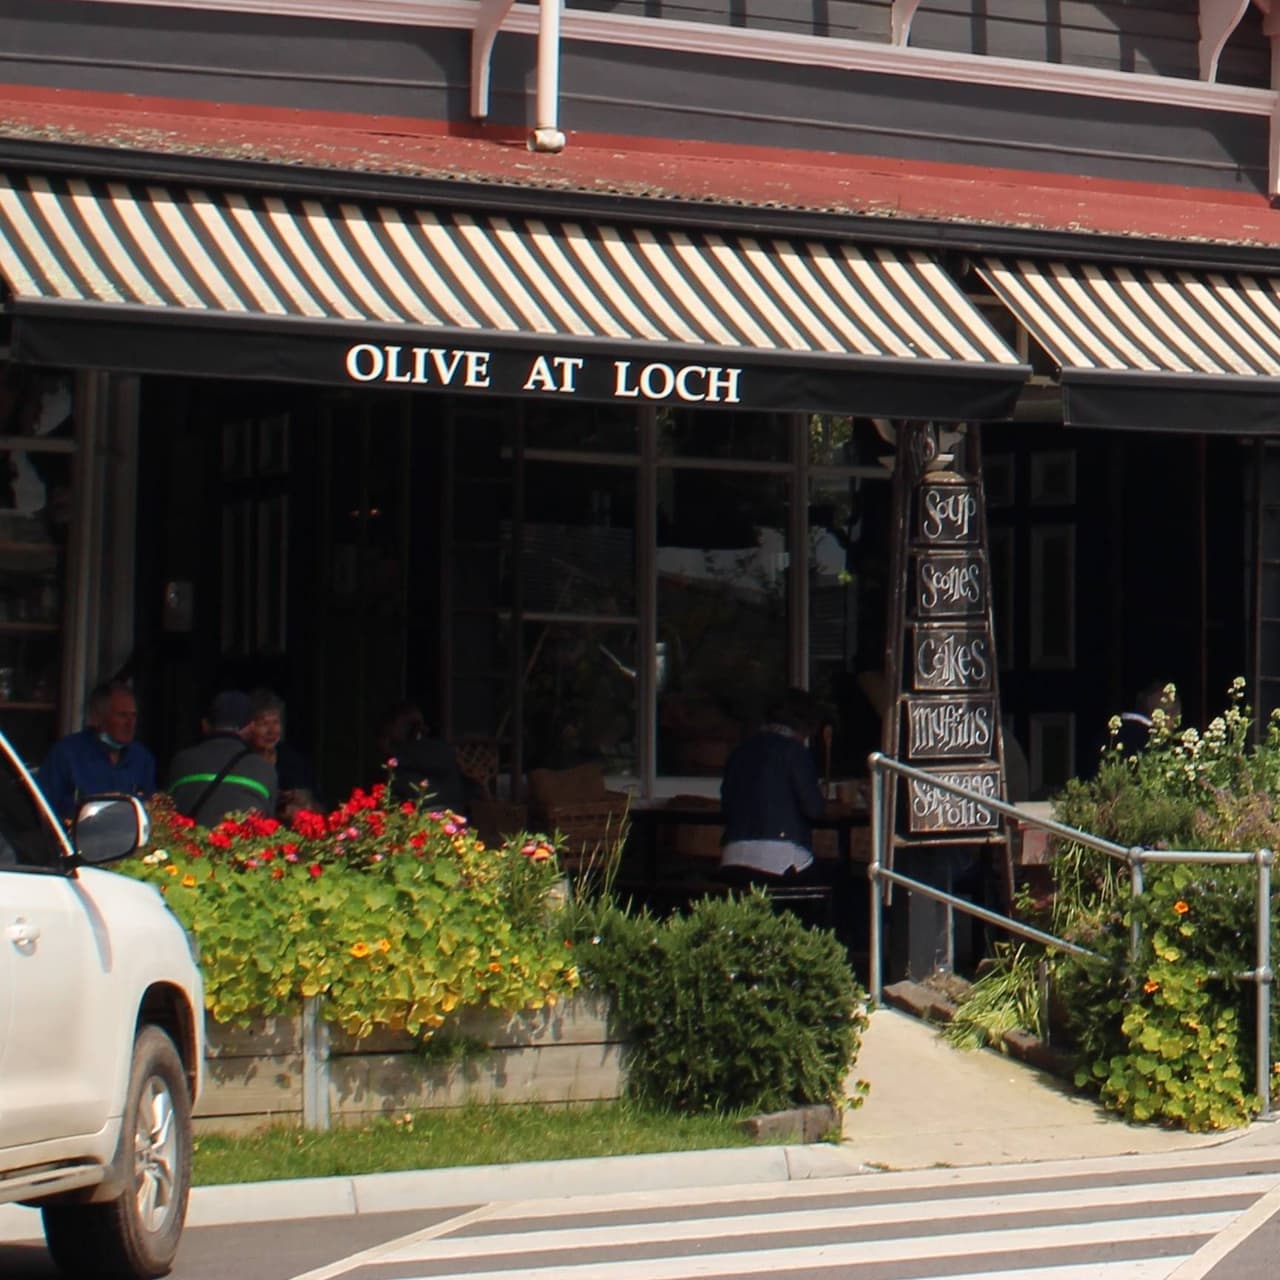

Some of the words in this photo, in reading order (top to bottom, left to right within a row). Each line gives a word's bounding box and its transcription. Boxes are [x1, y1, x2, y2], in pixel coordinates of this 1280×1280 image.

[345, 343, 491, 387] OLIVE
[523, 356, 583, 394] AT
[613, 361, 742, 403] LOCH
[923, 490, 977, 539] Soup
[922, 562, 980, 609] Scones
[917, 634, 986, 685] Cakes
